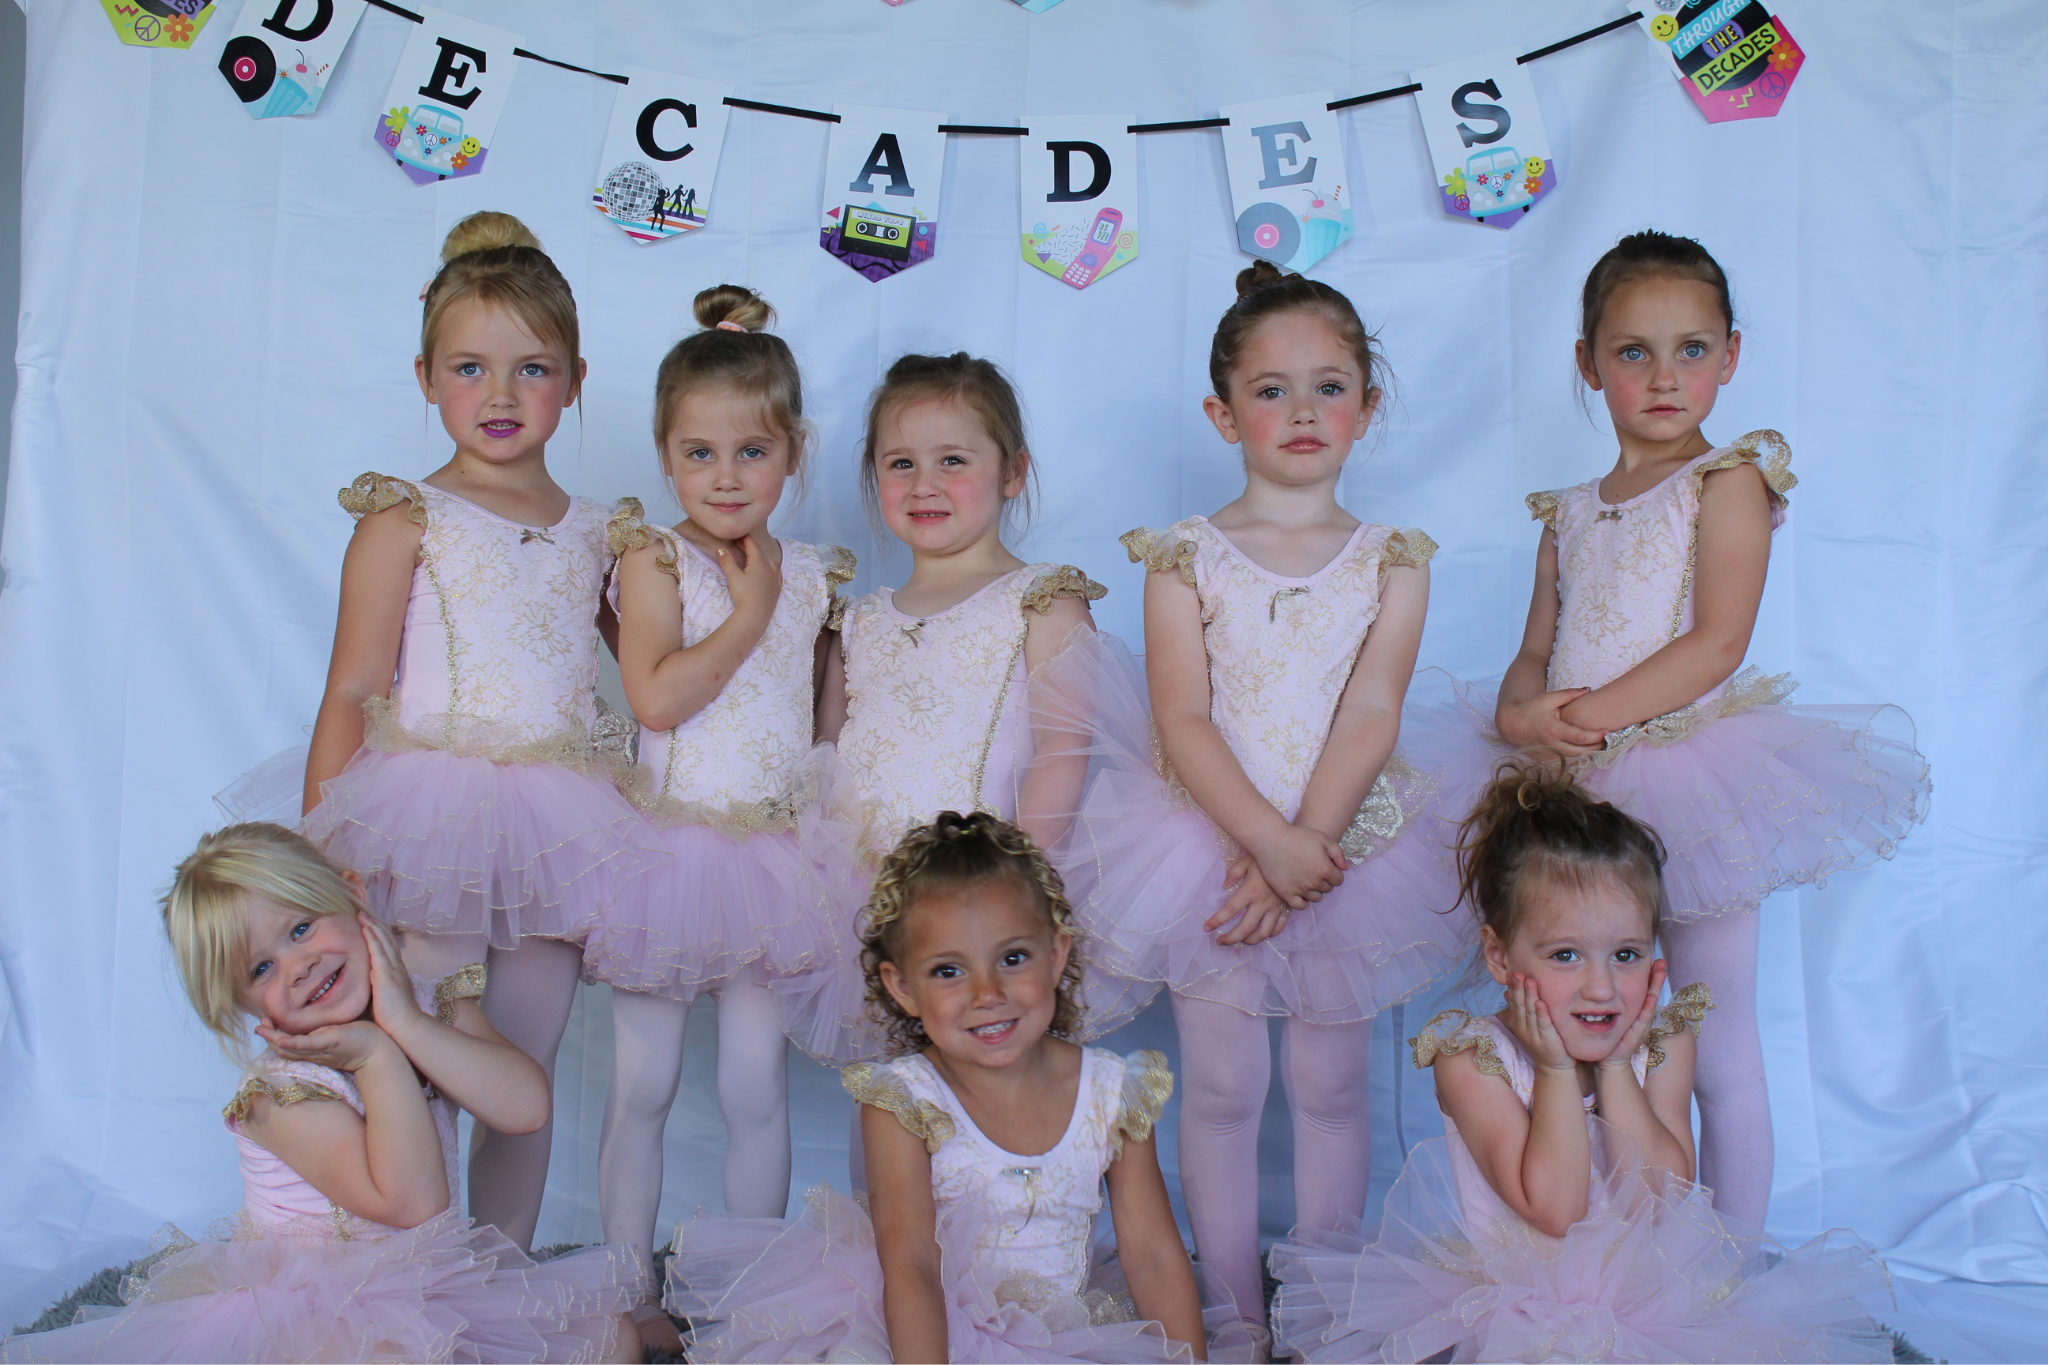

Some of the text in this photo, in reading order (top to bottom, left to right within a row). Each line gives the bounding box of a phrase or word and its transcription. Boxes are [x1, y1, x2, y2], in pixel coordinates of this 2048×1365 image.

[1697, 28, 1775, 90] DECADES
[1705, 25, 1740, 53] THE
[418, 37, 486, 110] E
[636, 98, 697, 161] C
[849, 133, 915, 197] A
[1047, 141, 1111, 202] D
[1251, 121, 1317, 189] E
[1451, 78, 1511, 148] S
